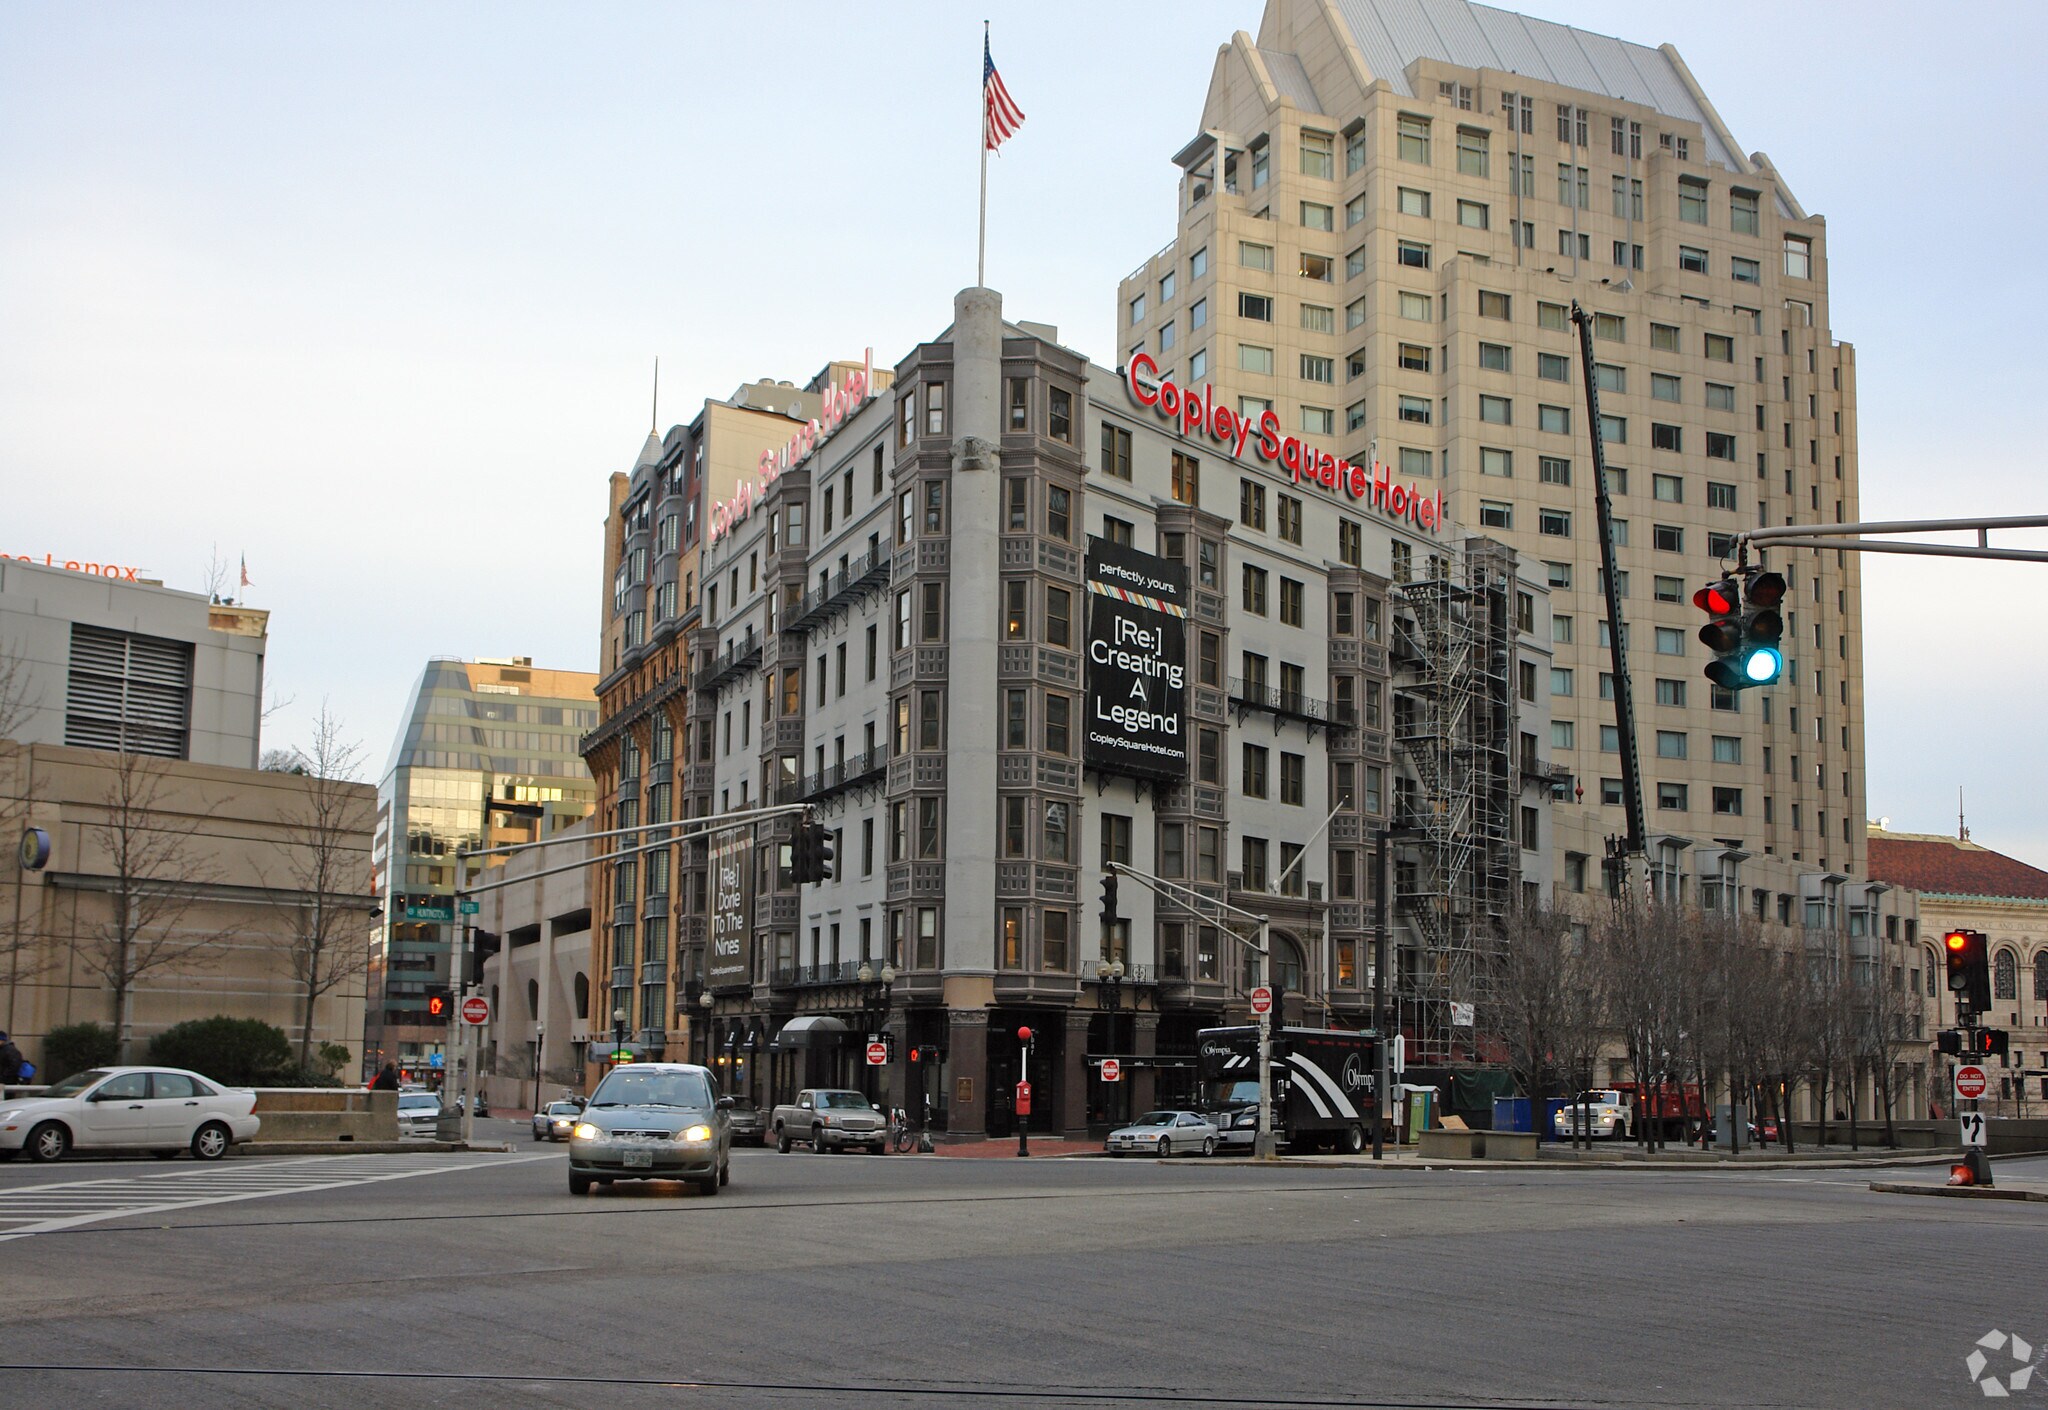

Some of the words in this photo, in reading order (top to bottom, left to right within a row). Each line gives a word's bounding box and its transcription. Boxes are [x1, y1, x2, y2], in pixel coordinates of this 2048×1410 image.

[710, 478, 753, 542] Copley
[758, 418, 819, 495] Square
[822, 347, 873, 433] Hotel
[1126, 352, 1252, 459] Copley
[1255, 409, 1367, 499] Square
[1369, 459, 1443, 534] Hotel
[1099, 562, 1146, 586] perfectly.
[1146, 576, 1177, 595] yours.
[1114, 615, 1162, 656] [Re:]
[1090, 639, 1184, 690] Creating
[1129, 677, 1147, 702] A
[1096, 695, 1178, 735] Legend
[1089, 731, 1185, 759] CopleySquareHotel.com
[718, 892, 741, 911] Done
[714, 915, 725, 934] To
[726, 912, 743, 930] The
[714, 938, 740, 957] Nines
[1205, 1045, 1231, 1056] Olympia
